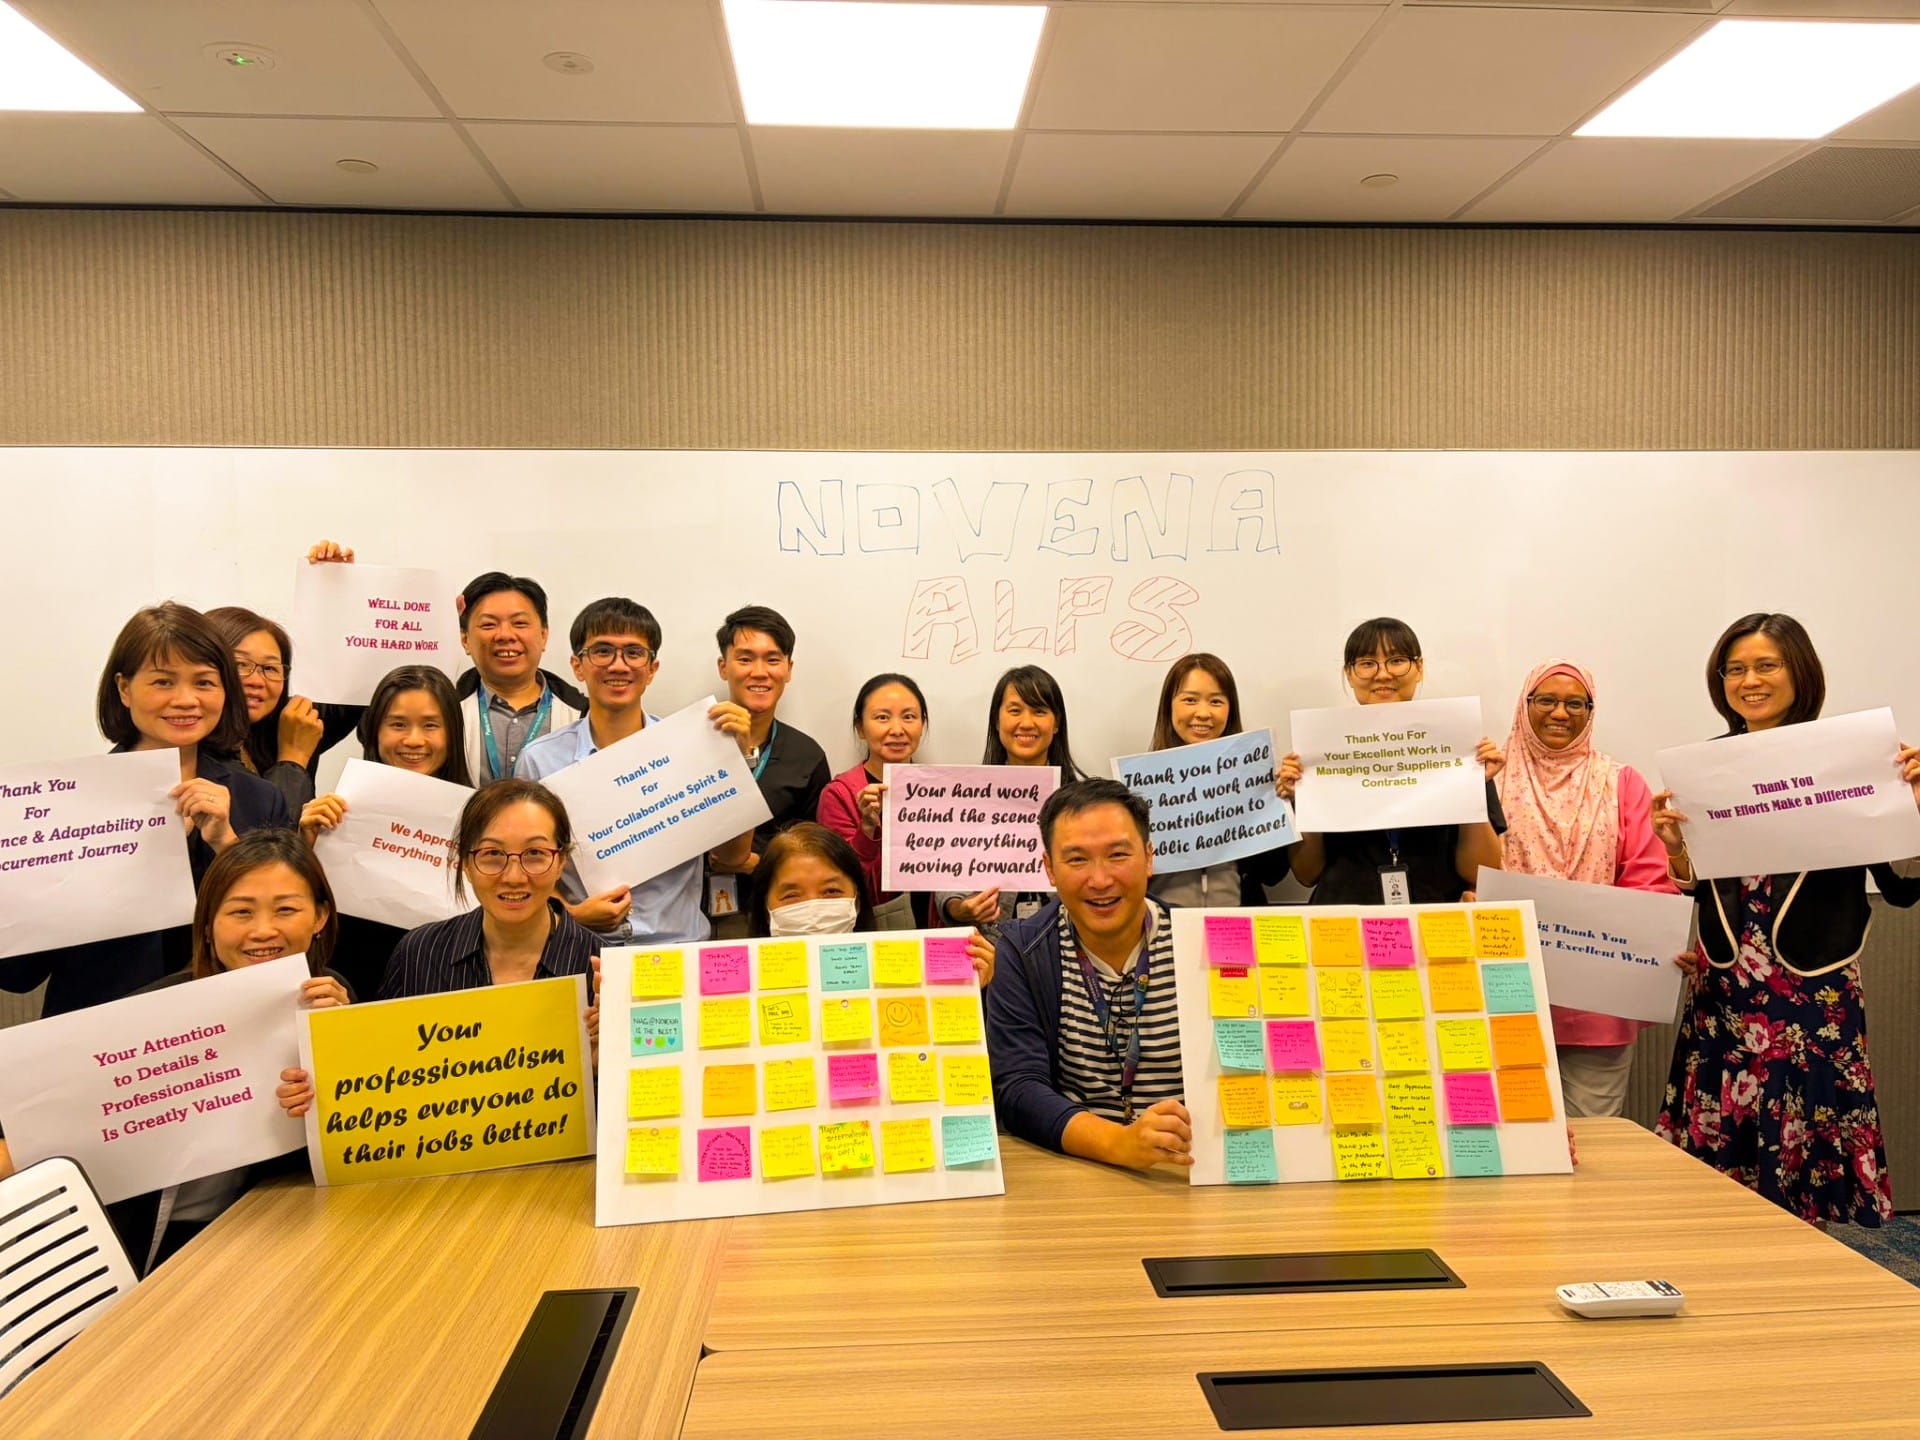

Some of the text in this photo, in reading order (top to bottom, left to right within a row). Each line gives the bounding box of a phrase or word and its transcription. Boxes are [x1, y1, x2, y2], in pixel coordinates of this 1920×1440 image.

[777, 469, 1281, 564] NOVENA
[368, 598, 431, 612] WELL DONE
[375, 619, 423, 631] FOR ALL
[902, 576, 1200, 665] ALPS
[345, 635, 439, 651] YOUR HARD WORK
[1345, 730, 1427, 745] Thank You For
[1124, 744, 1270, 788] Thank you for all
[1316, 758, 1463, 776] Managing Our Suppliers &
[1324, 744, 1451, 761] Your Excellent Work in
[613, 755, 670, 787] Thank You
[1361, 777, 1417, 788] Contracts
[1752, 775, 1815, 796] Thank You
[48, 779, 77, 793] You
[640, 782, 659, 796] For
[905, 782, 1040, 802] Your hard work
[1158, 786, 1197, 808] hard
[1202, 777, 1241, 800] work
[1244, 767, 1275, 789] and
[24, 806, 51, 820] For
[587, 768, 729, 842] Your Collaborative Spirit &
[897, 806, 954, 823] behind
[960, 807, 986, 823] the
[1149, 797, 1265, 834] contribution to
[1706, 784, 1875, 820] Your Efforts Make a Difference
[32, 830, 45, 844] &
[48, 818, 144, 841] Adaptability
[148, 815, 166, 827] on
[390, 822, 411, 837] We
[596, 786, 737, 860] Commitment to Excellence
[1151, 814, 1286, 857] ublic healthcare!
[78, 841, 139, 860] Journey
[372, 837, 442, 867] Everything
[905, 832, 1038, 853] keep everything
[899, 857, 1044, 877] moving forward!
[1537, 920, 1628, 945] ig Thank You
[1556, 940, 1615, 958] Excellent
[1621, 951, 1659, 967] Work
[93, 1023, 226, 1067] Your Attention
[416, 1021, 482, 1052] Your
[113, 1048, 219, 1088] to Details &
[335, 1046, 565, 1101] professionalism
[101, 1067, 242, 1116] Professionalism
[326, 1076, 578, 1134] helps everyone do
[101, 1086, 254, 1143] Is Greatly Valued
[342, 1113, 569, 1165] their jobs better!
